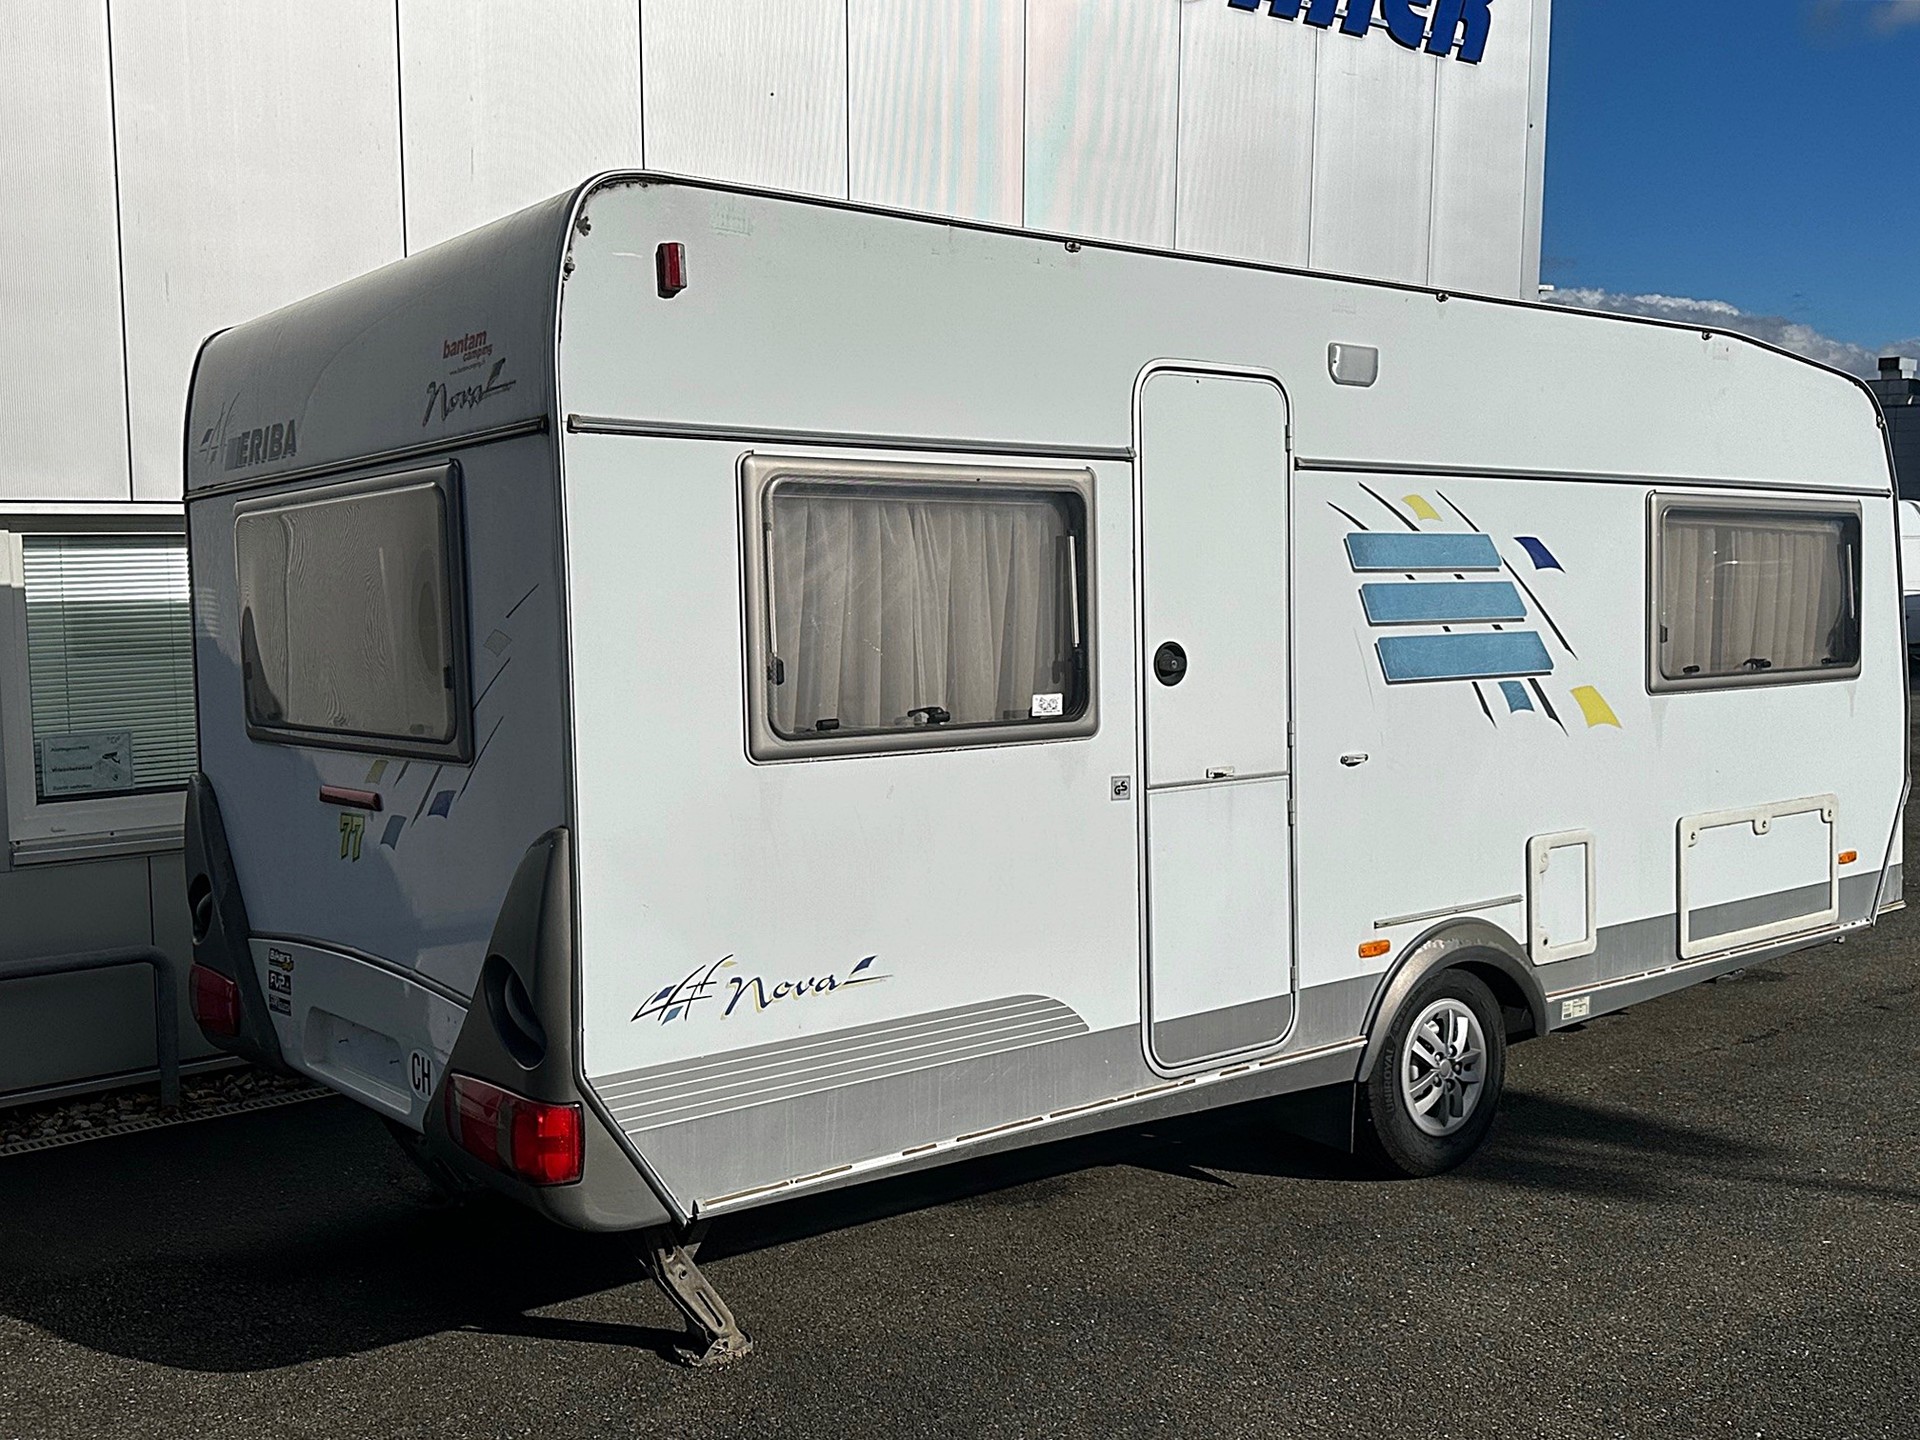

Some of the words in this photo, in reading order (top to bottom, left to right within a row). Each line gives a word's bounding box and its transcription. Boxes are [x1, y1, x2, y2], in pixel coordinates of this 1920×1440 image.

[443, 331, 487, 359] bantam
[237, 419, 297, 467] ERIBA
[340, 812, 365, 862] 77
[411, 1052, 431, 1096] CH
[1383, 1046, 1395, 1113] UNIROYAL
